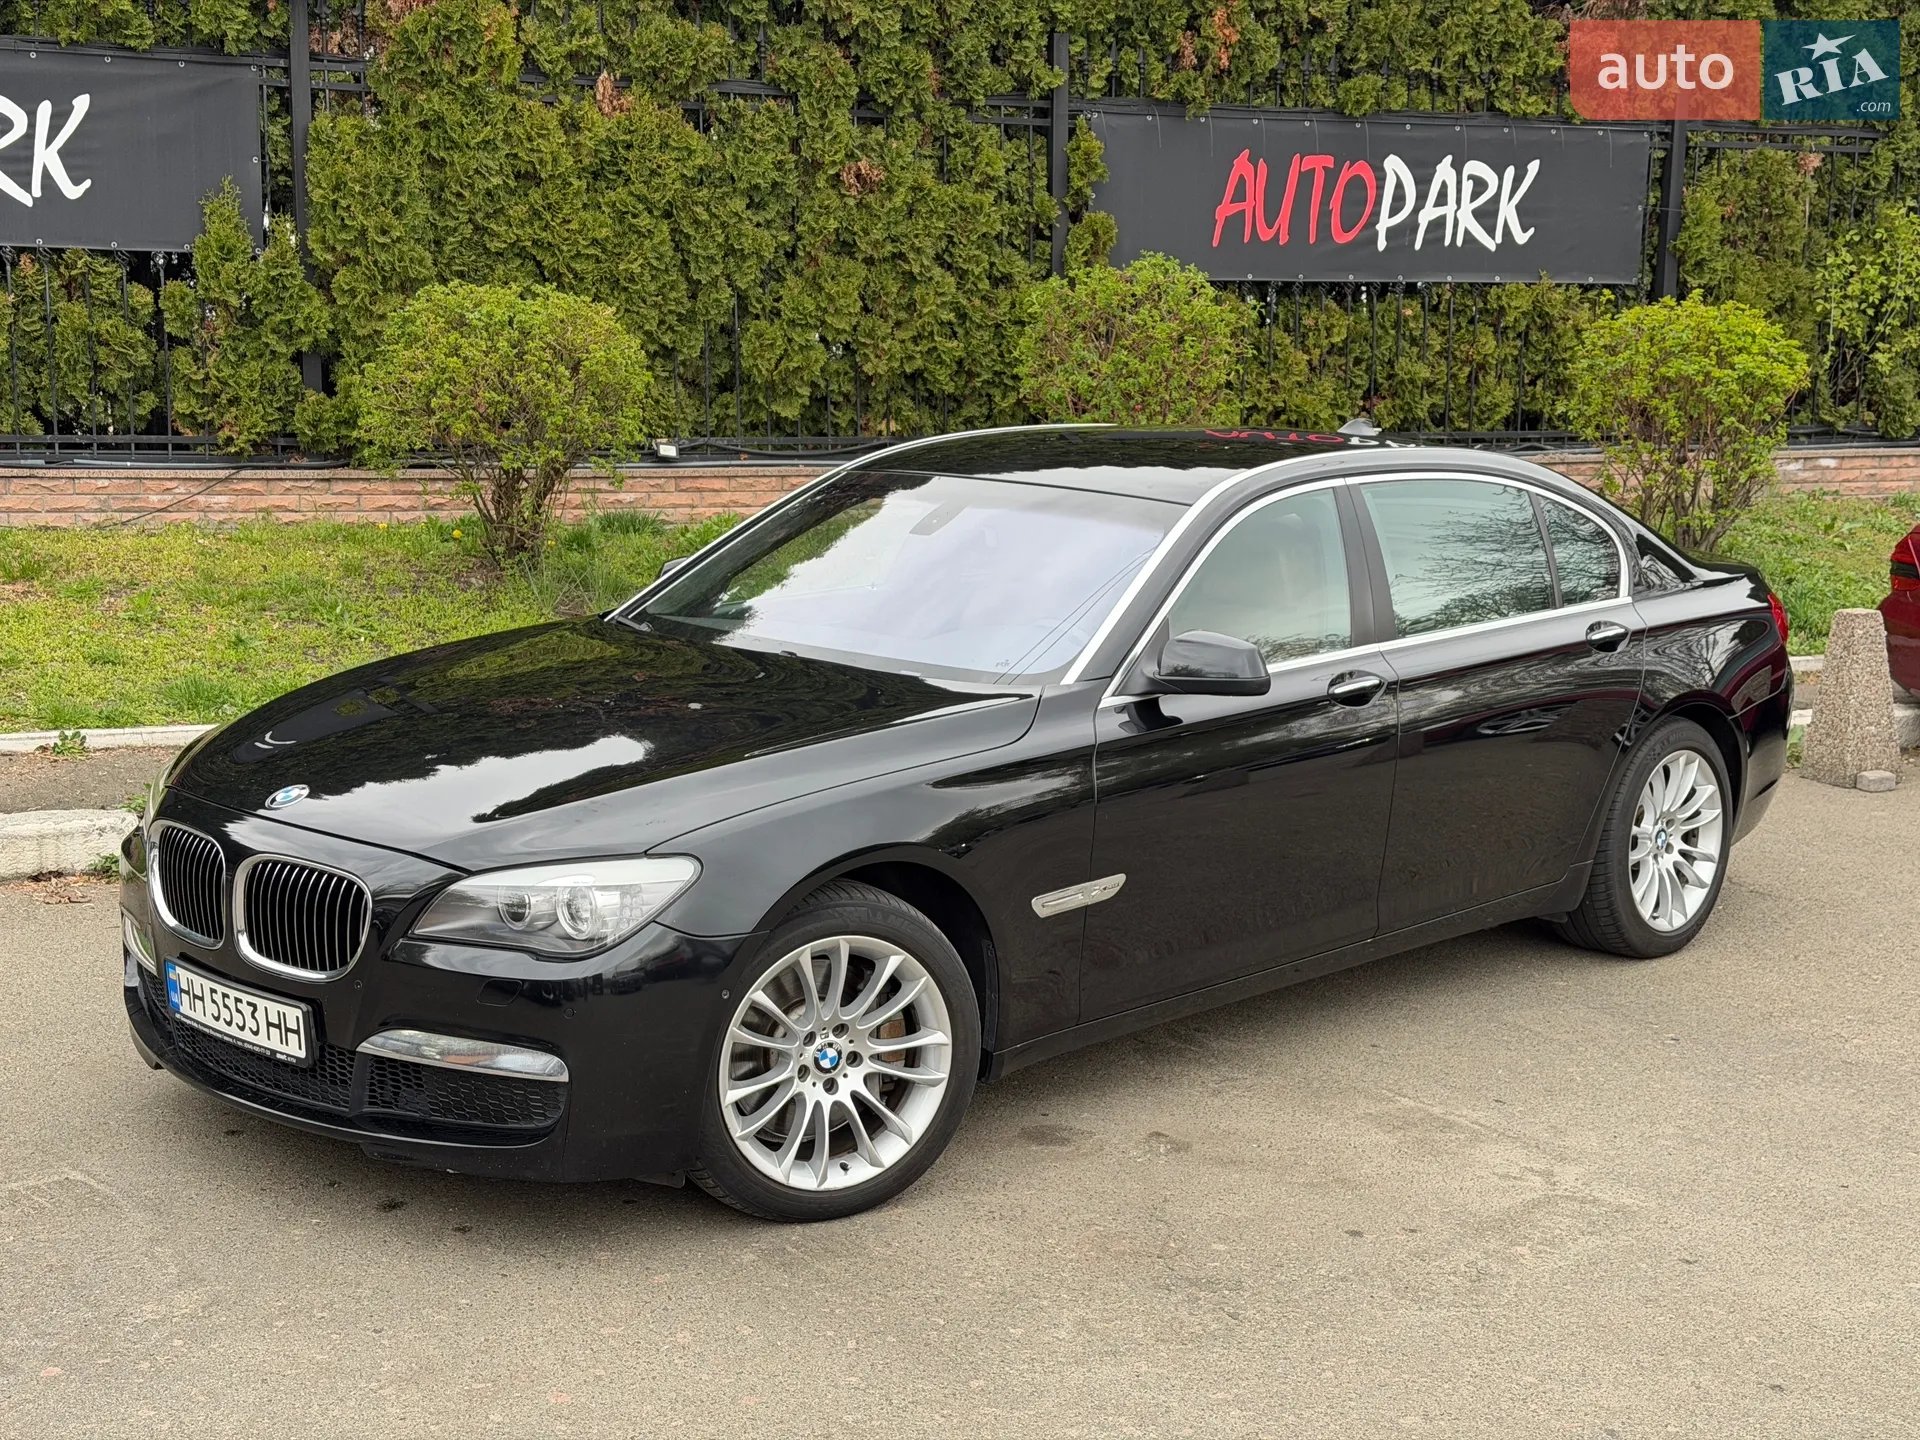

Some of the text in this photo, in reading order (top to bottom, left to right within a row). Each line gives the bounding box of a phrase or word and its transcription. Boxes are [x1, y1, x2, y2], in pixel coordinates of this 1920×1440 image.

[1212, 149, 1541, 253] AUTOPARK
[209, 986, 261, 1036] 5553
[263, 1005, 303, 1052] HH
